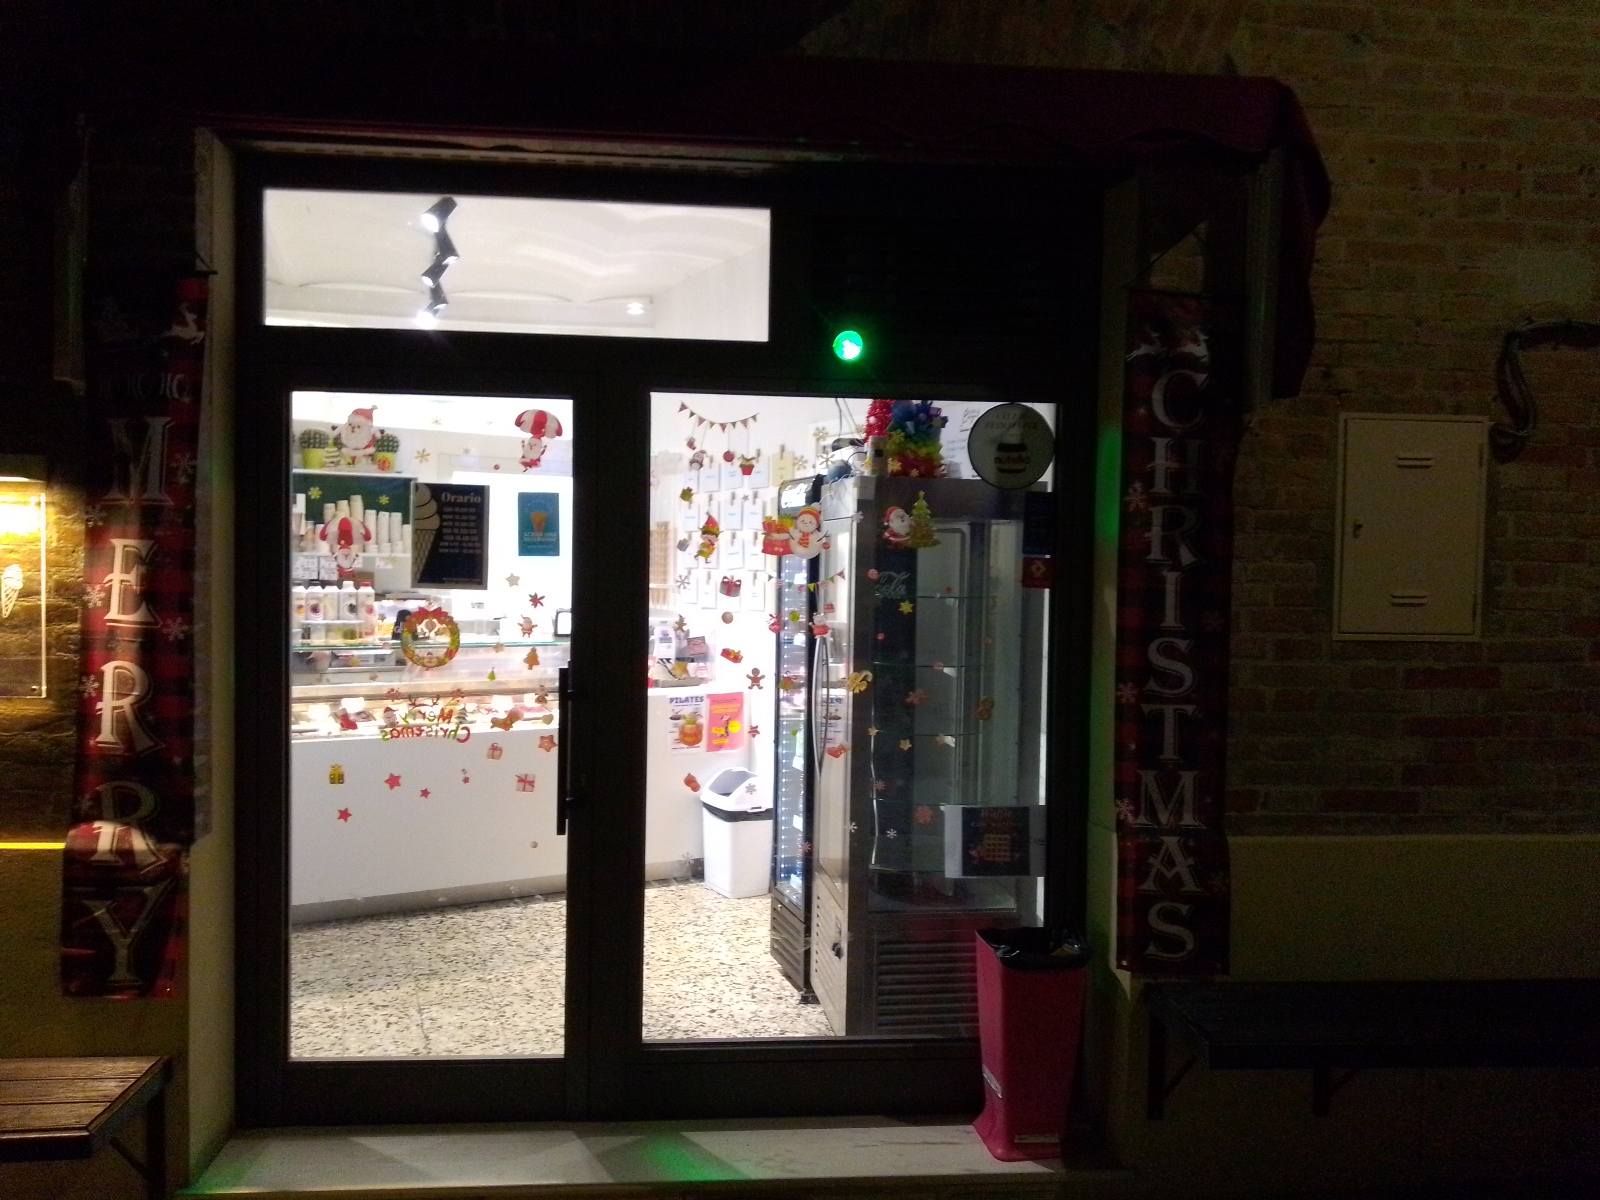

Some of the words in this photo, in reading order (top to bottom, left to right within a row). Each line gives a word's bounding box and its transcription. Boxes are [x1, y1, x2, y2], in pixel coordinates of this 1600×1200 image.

[441, 491, 482, 504] Orario
[78, 414, 175, 989] MERRY
[669, 695, 705, 704] PILATES
[1133, 368, 1208, 962] CHRISTMAS
